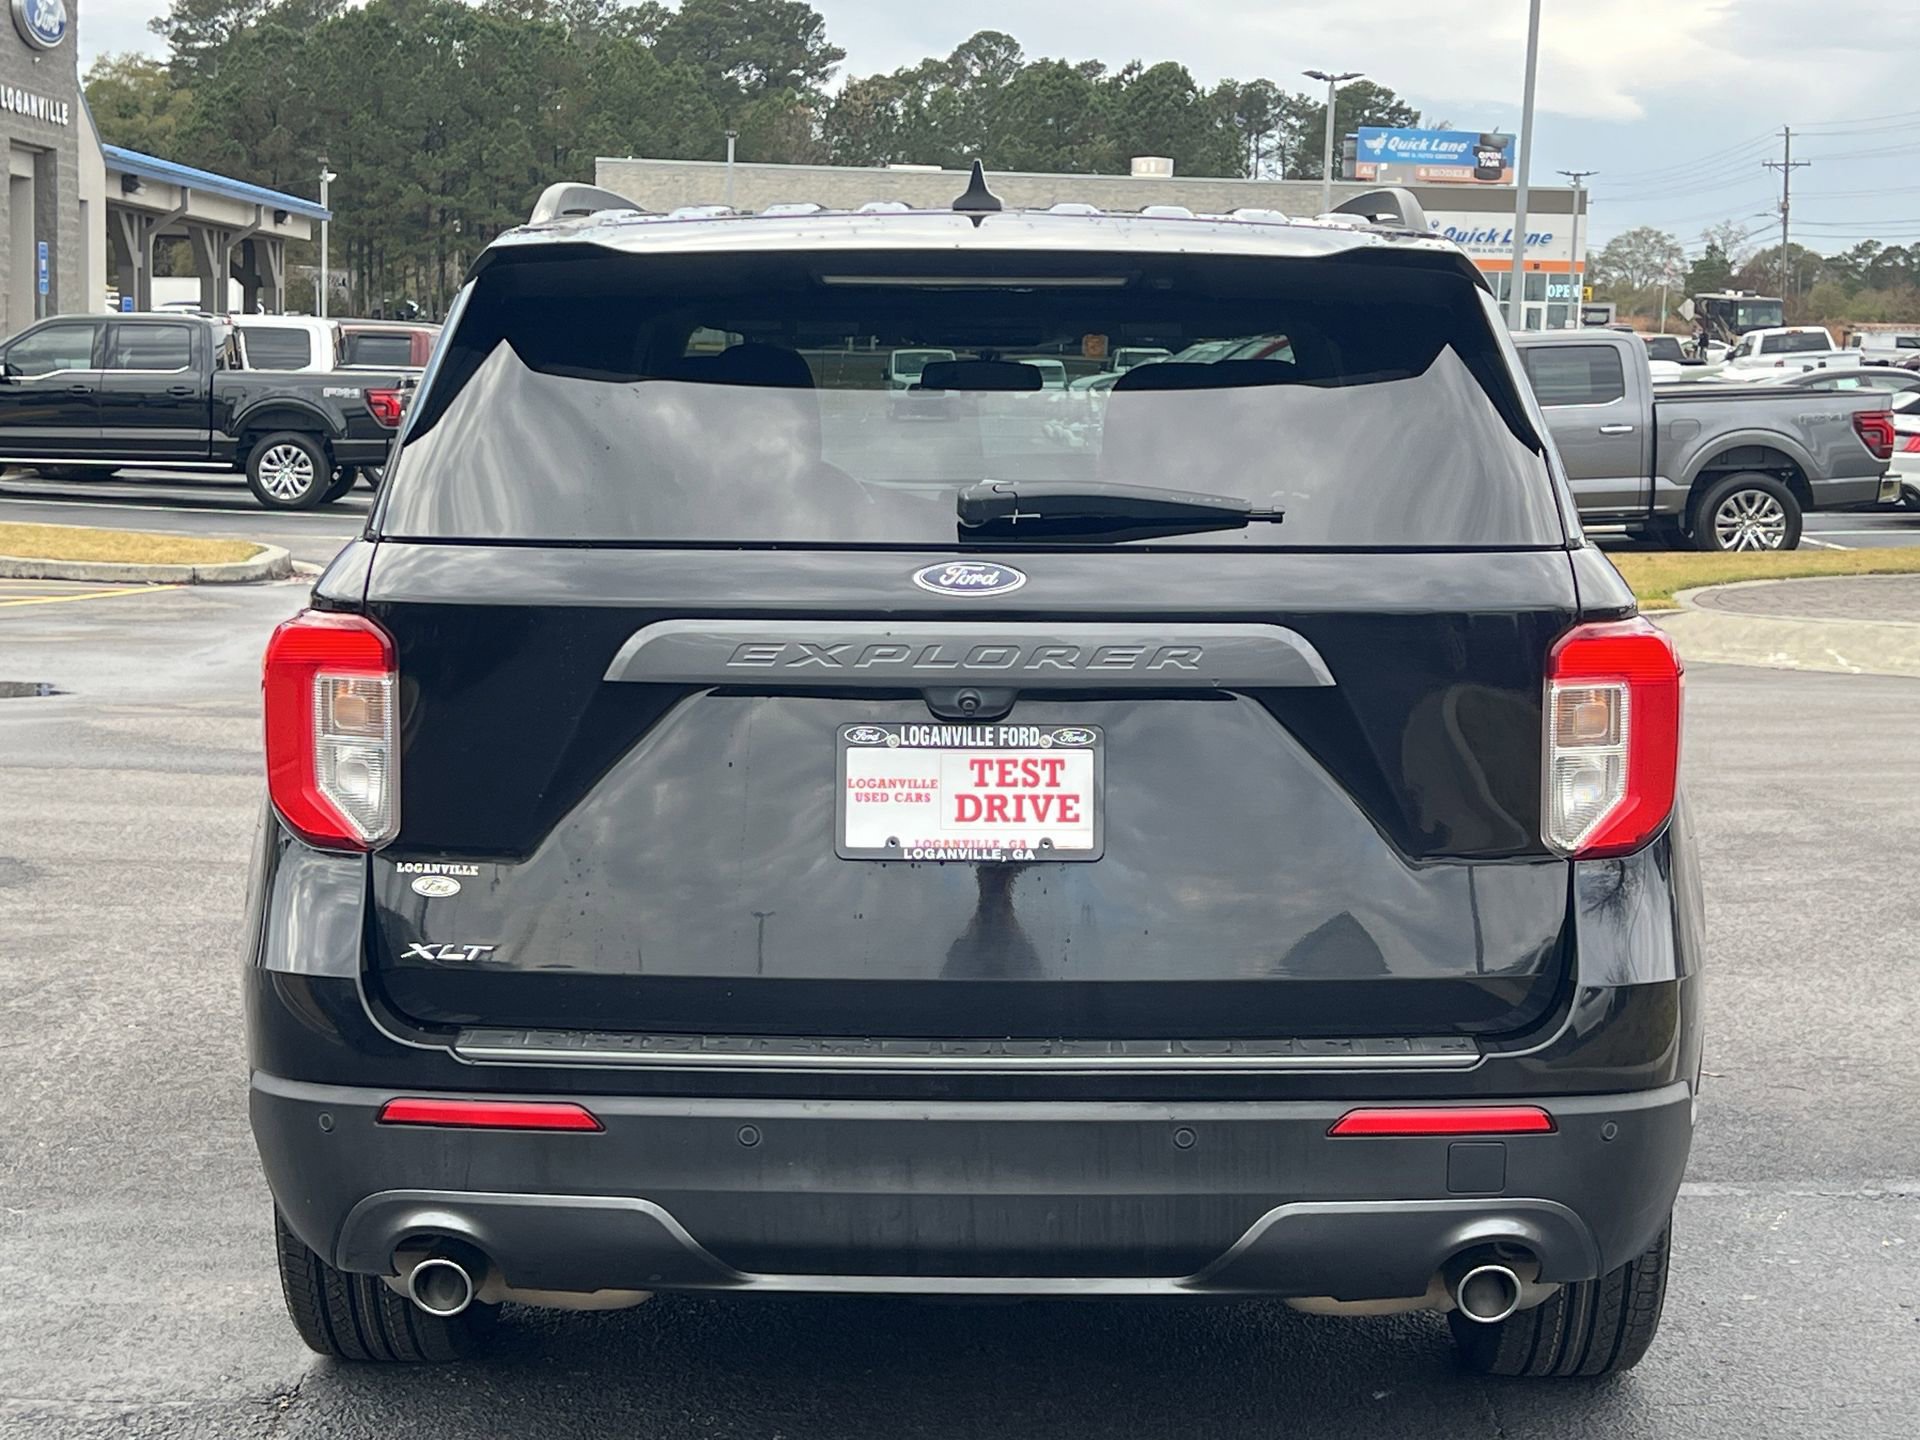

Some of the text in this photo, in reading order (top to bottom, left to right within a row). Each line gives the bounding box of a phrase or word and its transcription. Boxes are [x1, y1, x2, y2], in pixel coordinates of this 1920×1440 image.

[0, 84, 68, 125] LOGANVILLE
[1387, 136, 1467, 153] Quick Lane
[1478, 151, 1502, 160] OPEN
[1480, 159, 1500, 168] 7AM
[1429, 168, 1472, 178] MODELS
[1444, 226, 1553, 246] Quick Lne
[1548, 284, 1580, 298] OPEN
[939, 565, 1001, 586] Ford
[726, 642, 1205, 671] EXPLORER
[852, 729, 881, 741] Ford
[900, 725, 1040, 747] LOGANVILLE FORD
[1059, 731, 1088, 743] Ford
[969, 759, 1065, 788] TEST
[848, 778, 938, 790] LOGANVILLE
[855, 792, 931, 803] USED CARS
[954, 794, 1080, 823] DRIVE
[1008, 839, 1027, 849] GA
[903, 848, 1035, 862] LOGANVILLE, GA
[396, 862, 479, 876] LOGANVILLE
[400, 943, 496, 961] XLT
